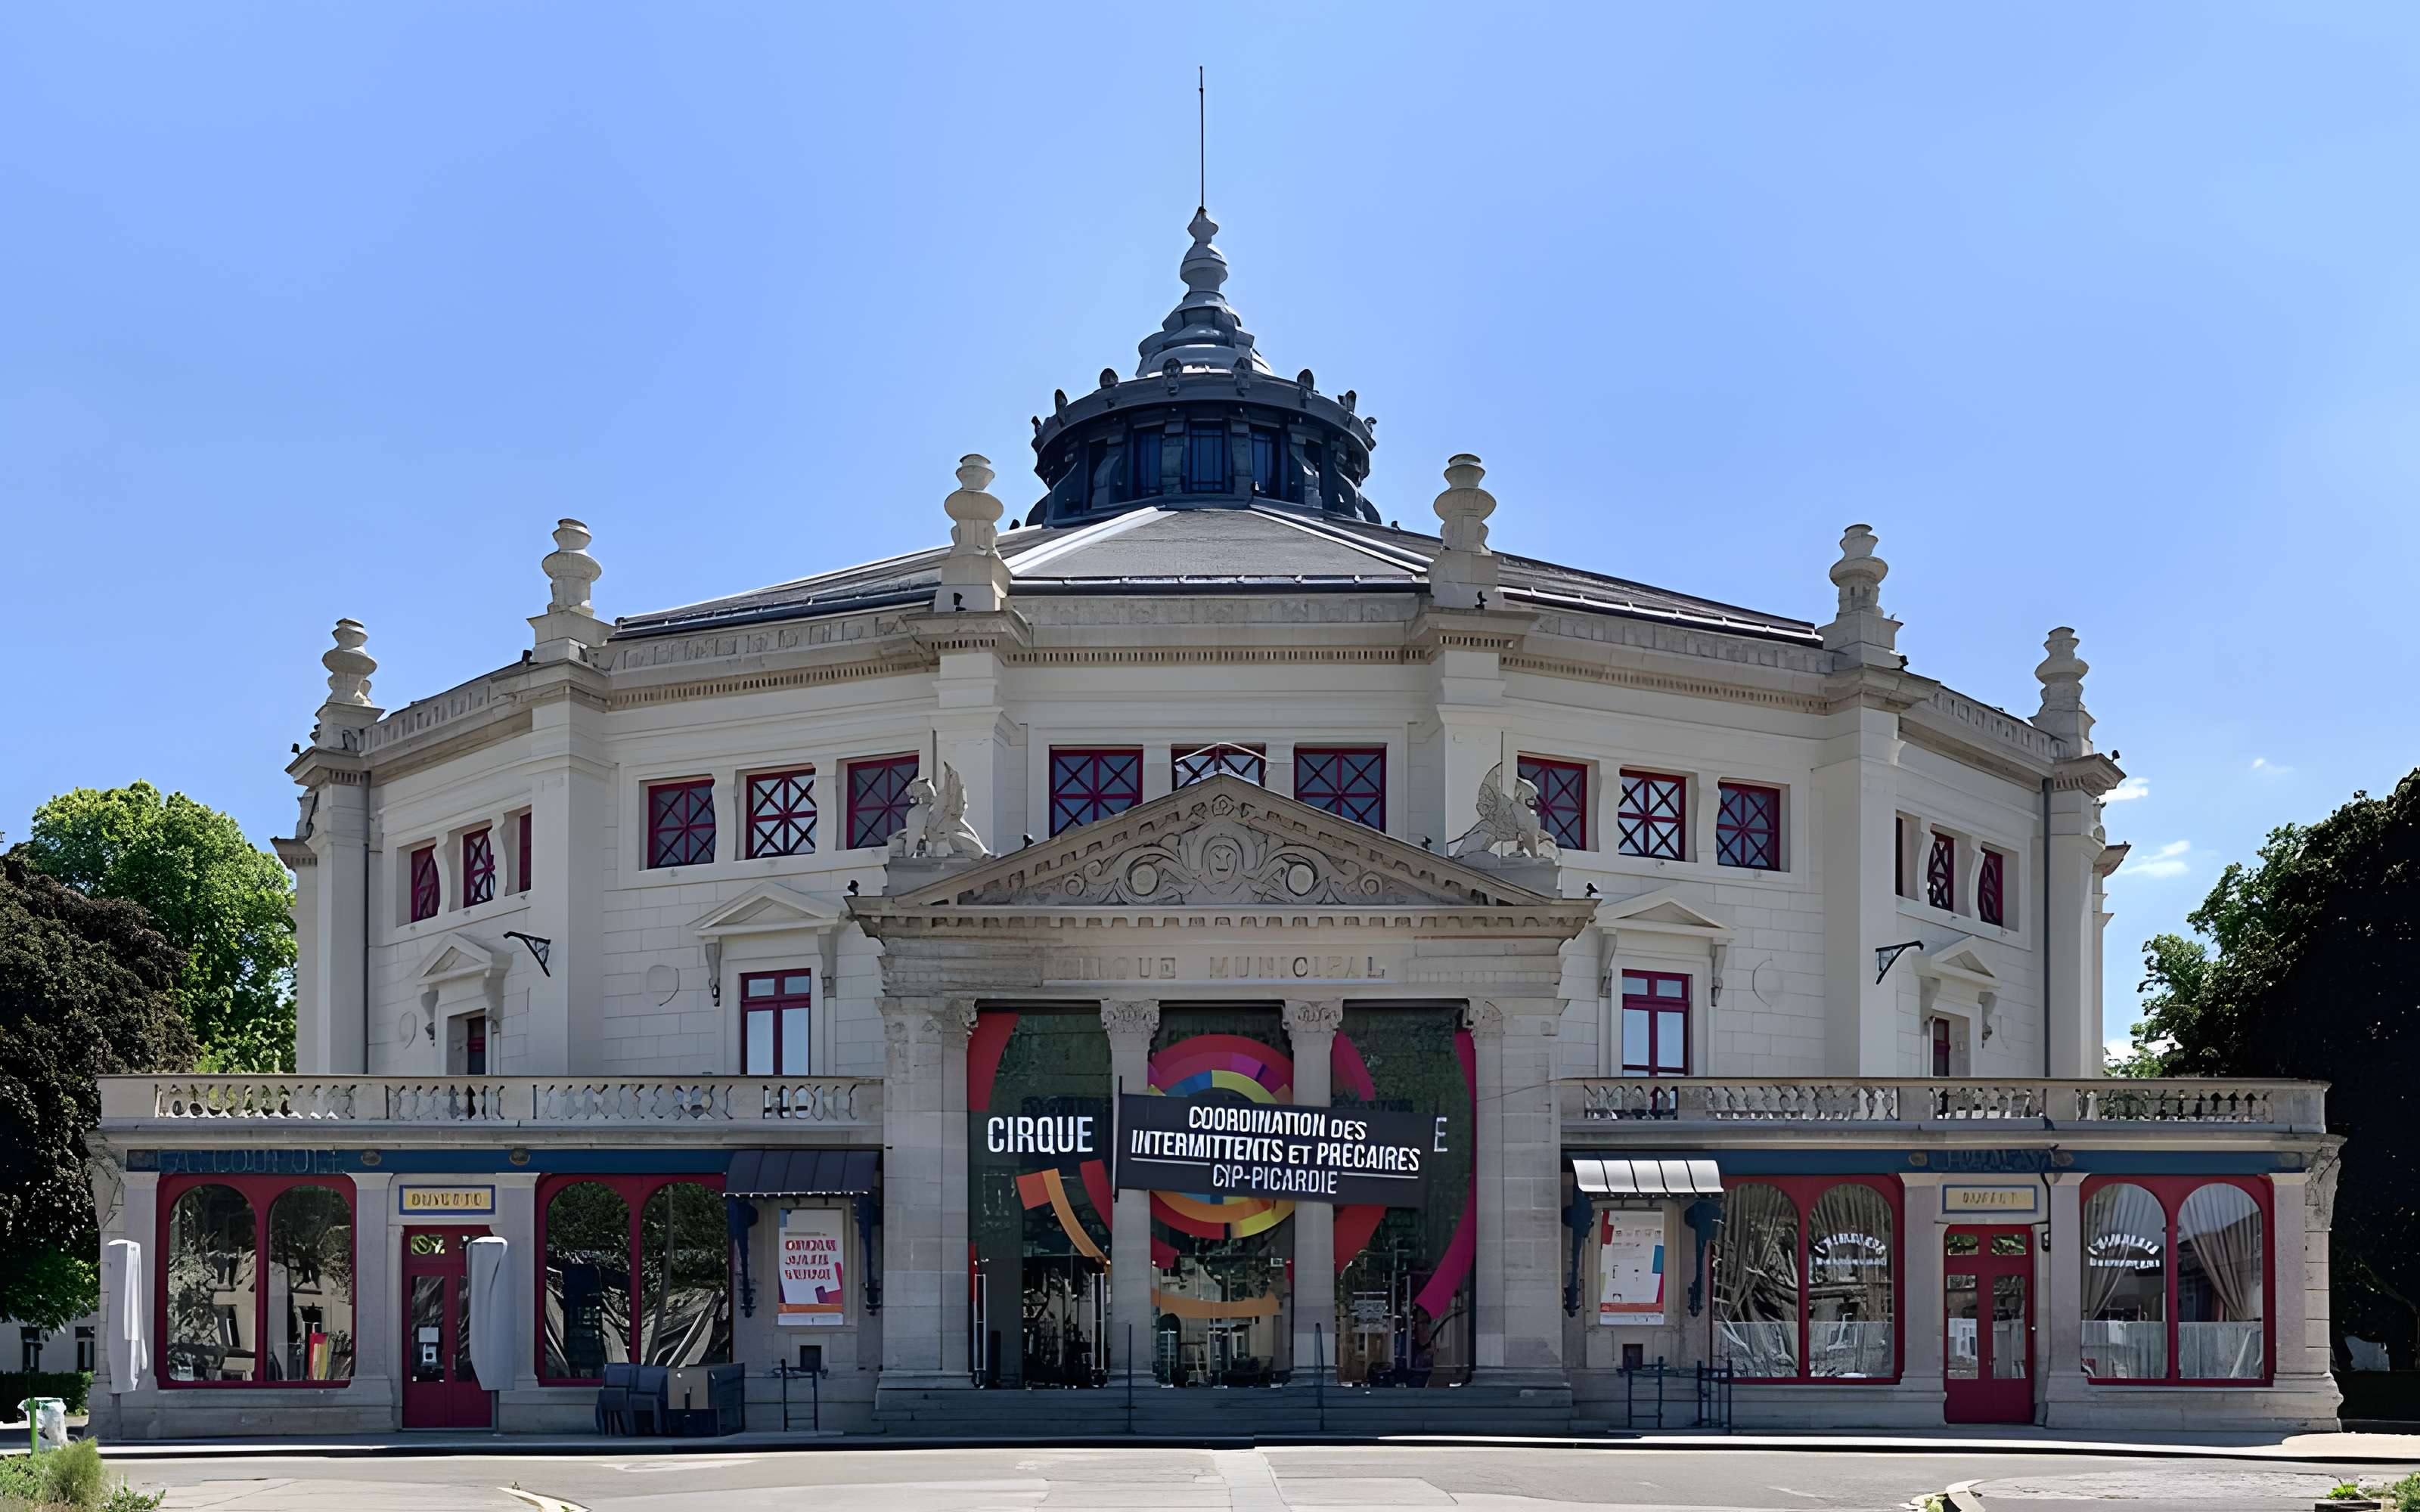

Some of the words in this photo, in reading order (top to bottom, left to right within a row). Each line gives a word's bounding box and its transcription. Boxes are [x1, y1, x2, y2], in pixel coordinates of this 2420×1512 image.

[988, 1116, 1094, 1154] CIRQUE
[1189, 1105, 1326, 1138] COORDINATION
[1330, 1119, 1367, 1141] DES
[1131, 1129, 1283, 1163] INTERMITTENTS
[1288, 1144, 1313, 1165] ET
